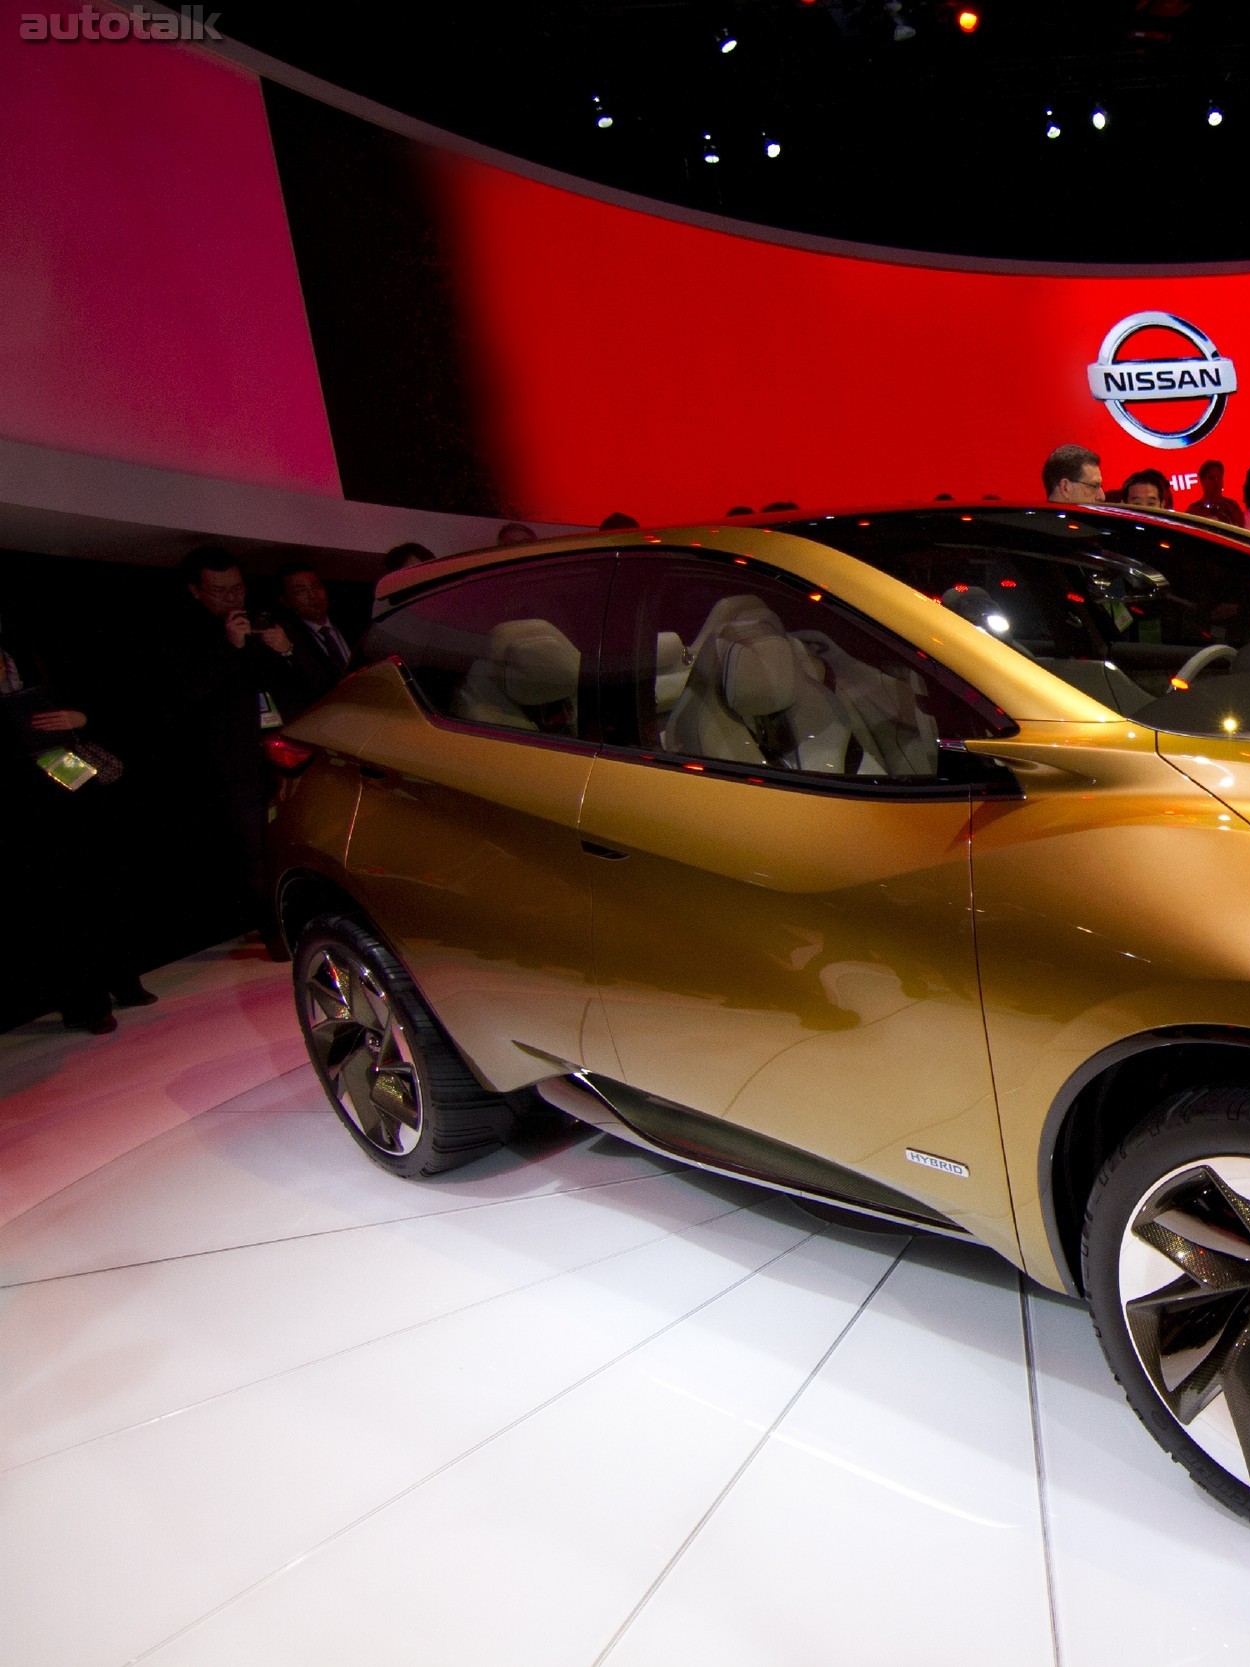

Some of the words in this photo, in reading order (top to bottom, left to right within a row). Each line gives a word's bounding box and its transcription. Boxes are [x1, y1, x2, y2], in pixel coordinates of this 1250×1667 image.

[1103, 367, 1222, 392] NISSAN
[1169, 473, 1198, 491] HIF
[910, 1152, 963, 1174] HYBRID
